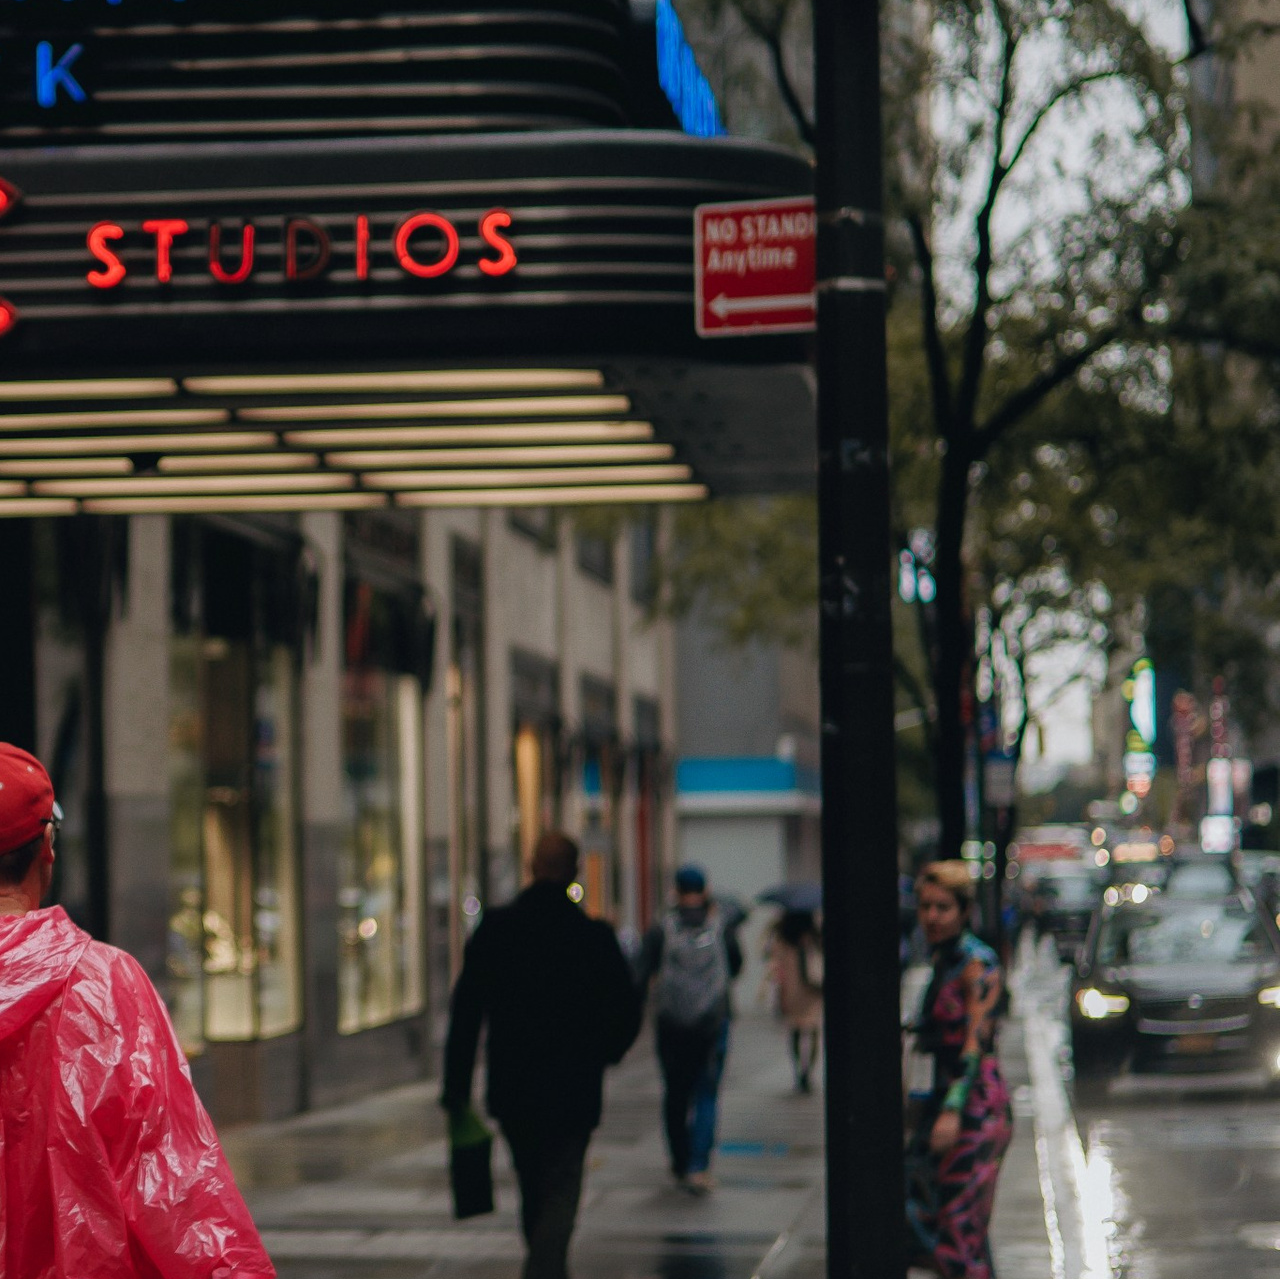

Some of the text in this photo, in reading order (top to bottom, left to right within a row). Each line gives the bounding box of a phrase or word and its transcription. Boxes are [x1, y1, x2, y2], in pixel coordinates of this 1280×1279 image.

[705, 217, 738, 245] NO
[85, 208, 518, 290] STUDIOS
[706, 244, 798, 278] Anytime
